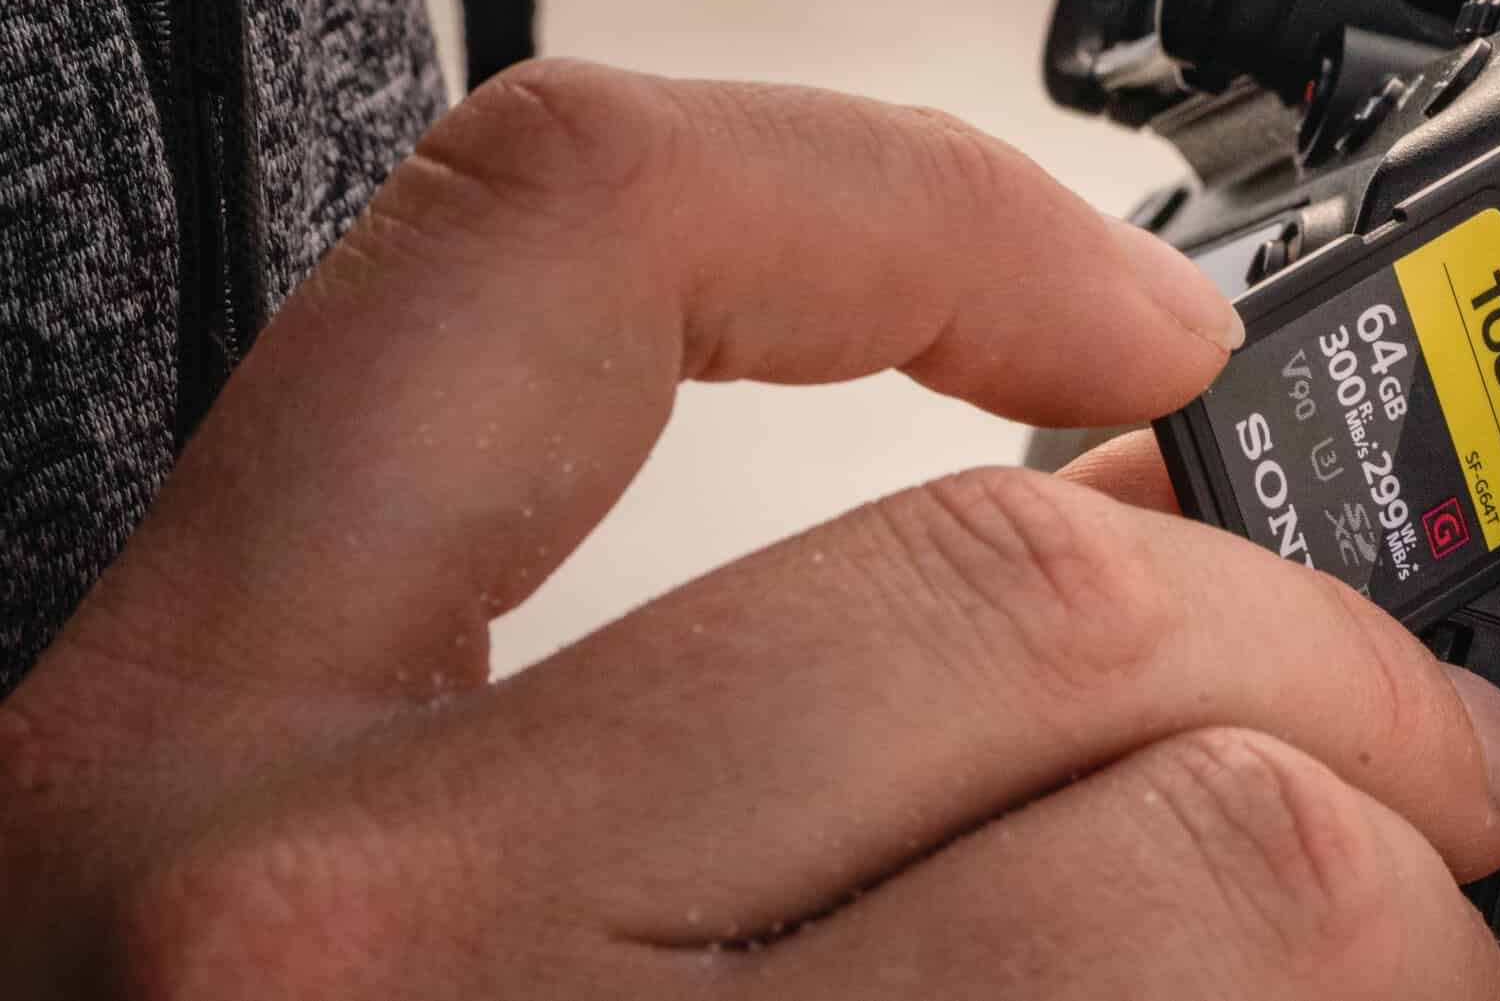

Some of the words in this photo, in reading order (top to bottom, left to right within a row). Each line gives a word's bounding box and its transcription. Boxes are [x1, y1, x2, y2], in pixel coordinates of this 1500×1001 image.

[1281, 349, 1317, 421] V90
[1319, 325, 1367, 407] 300
[1235, 412, 1315, 571] SON
[1361, 450, 1409, 530] 299
[1465, 450, 1500, 525] SF-G64T
